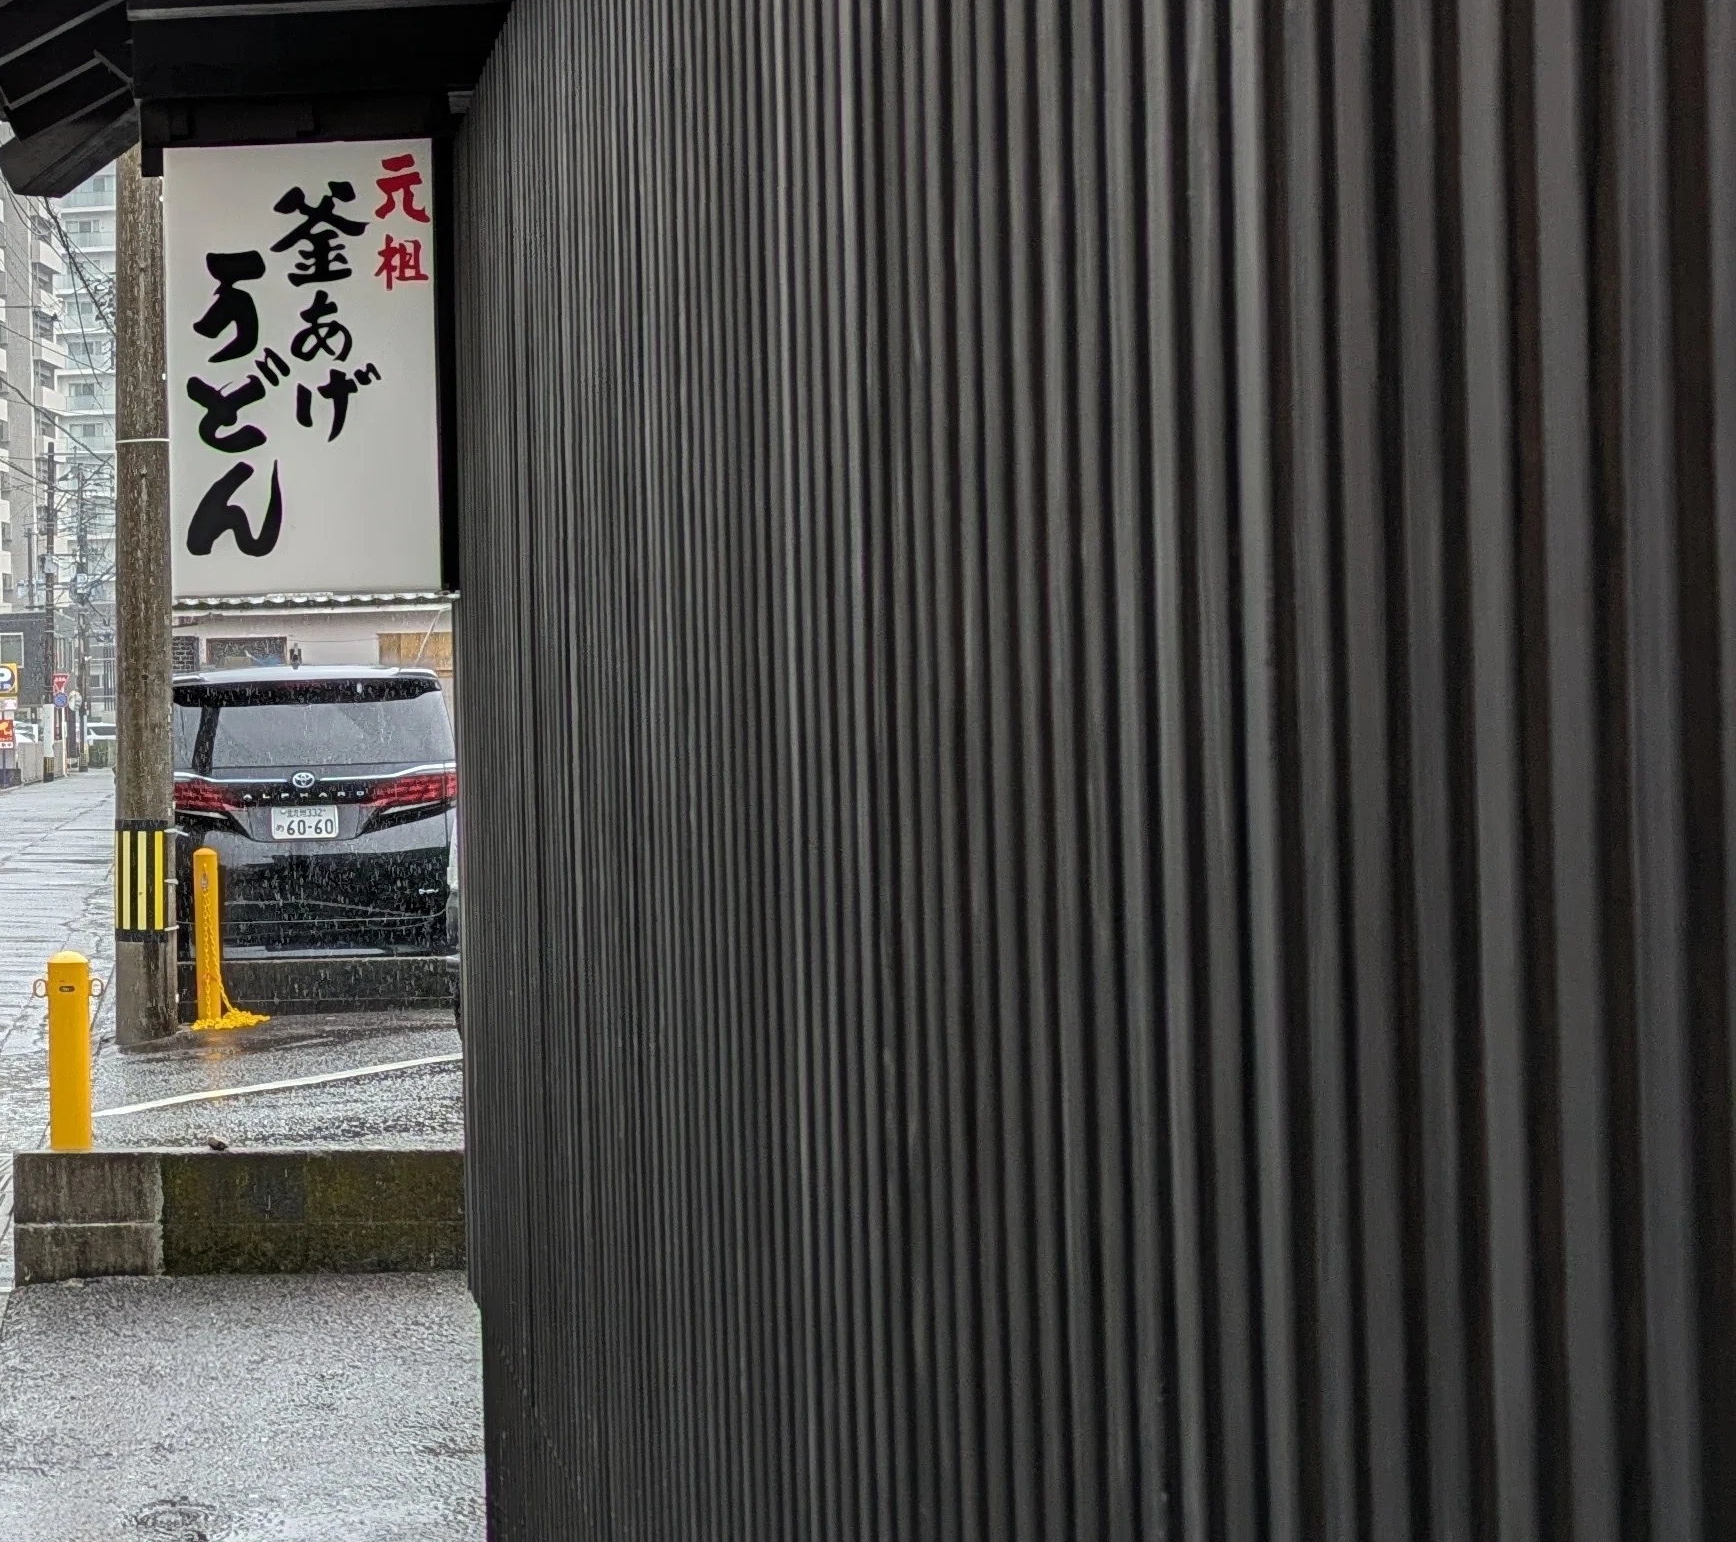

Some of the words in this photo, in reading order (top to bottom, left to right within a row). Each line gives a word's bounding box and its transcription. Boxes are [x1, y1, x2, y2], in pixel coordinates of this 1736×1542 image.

[374, 153, 431, 291] 元祖
[270, 181, 382, 443] 釜あげ
[186, 249, 291, 558] うどん
[243, 790, 365, 800] ALPHARD
[286, 818, 334, 836] 60-60
